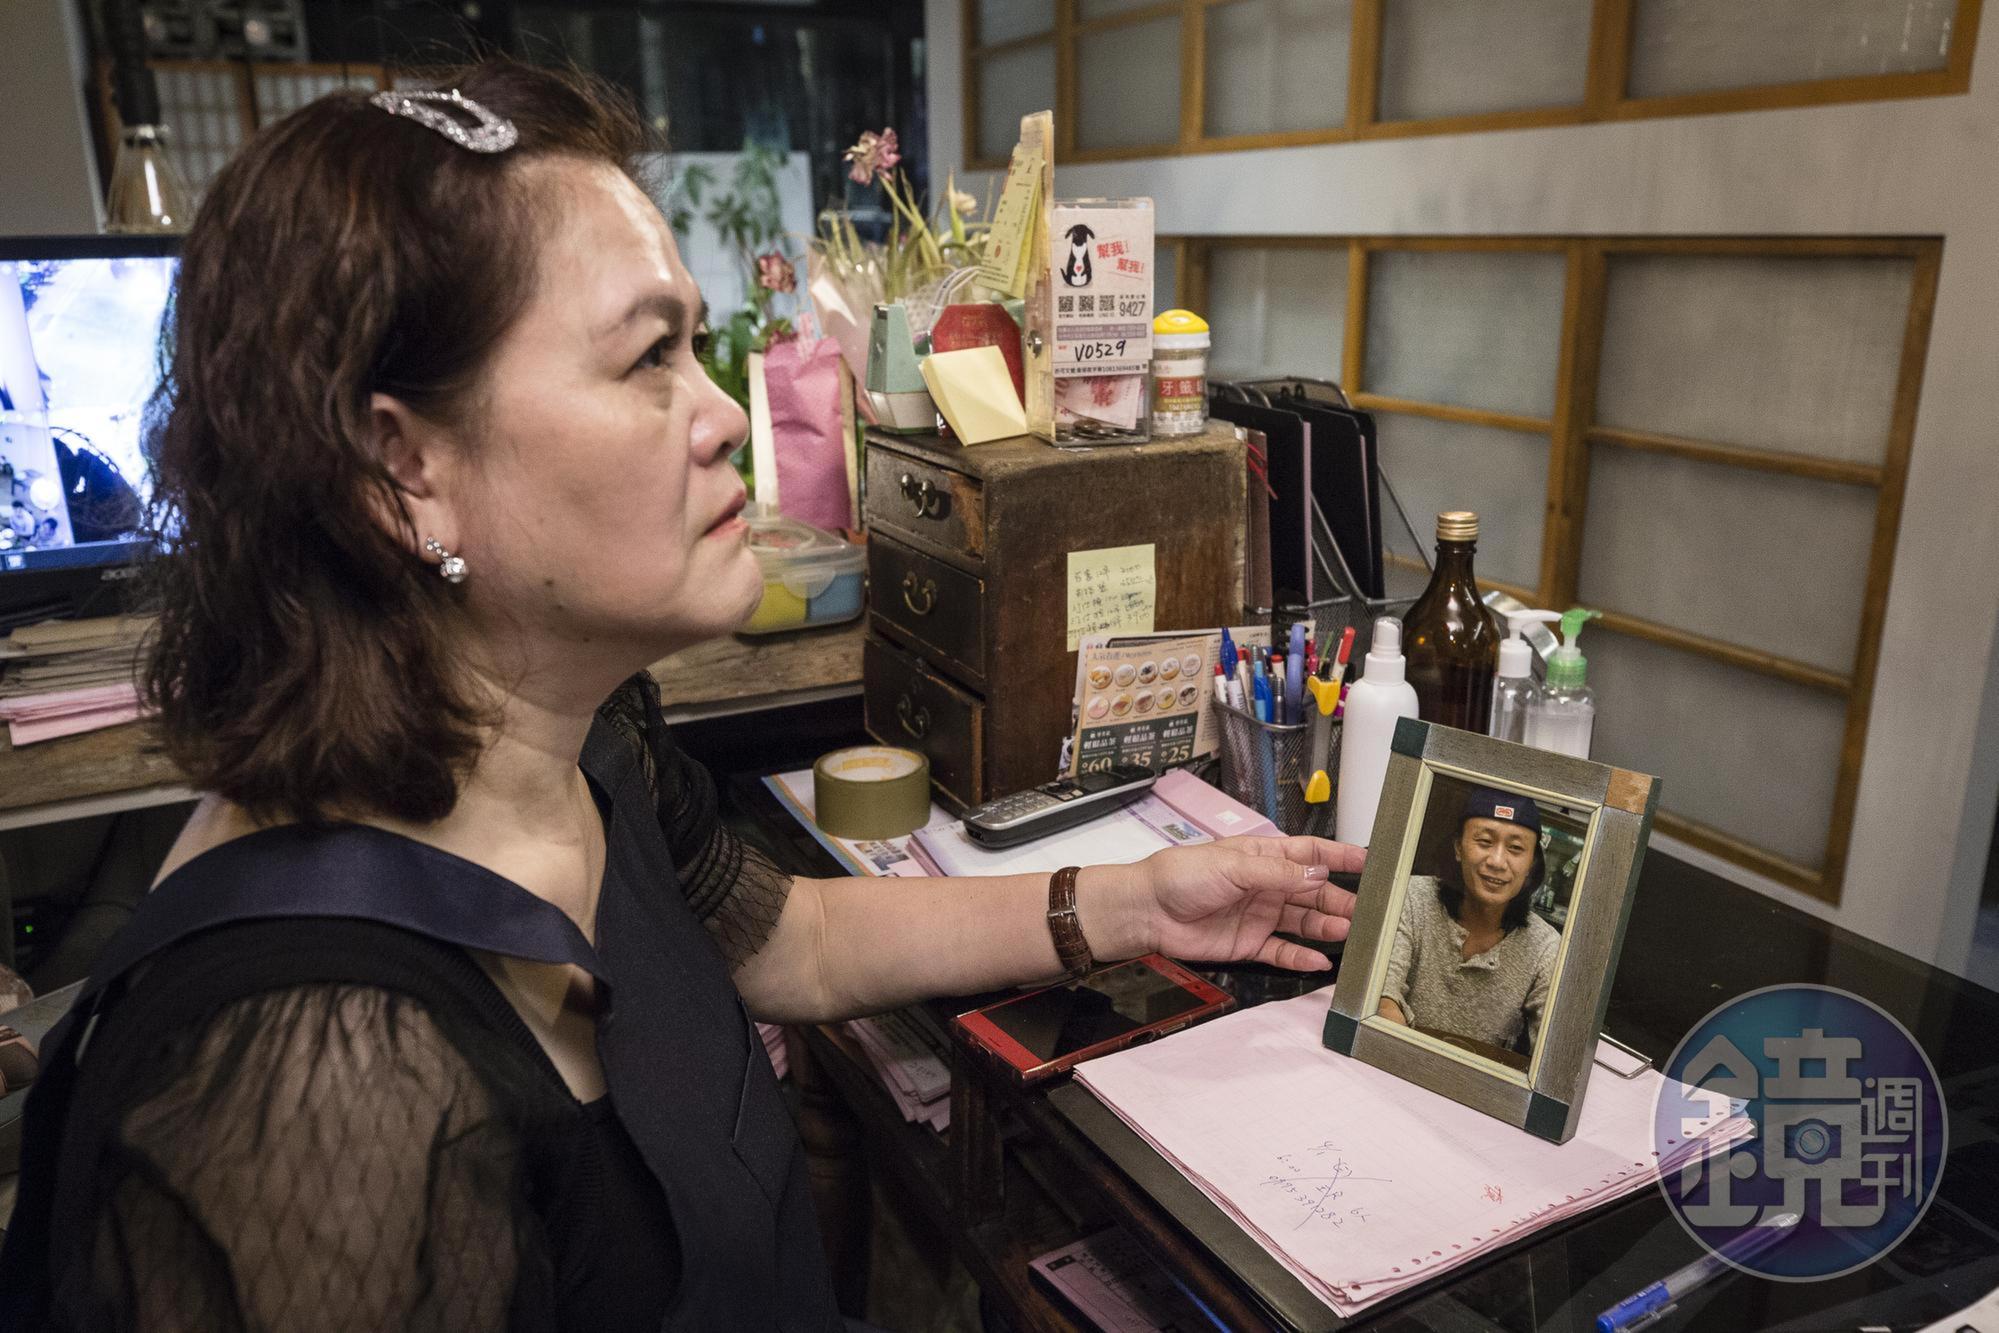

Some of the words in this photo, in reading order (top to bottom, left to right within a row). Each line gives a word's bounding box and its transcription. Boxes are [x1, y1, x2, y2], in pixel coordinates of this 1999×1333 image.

[1119, 301, 1146, 317] 9427
[1074, 339, 1127, 361] V0529
[1167, 744, 1191, 763] 25
[1088, 756, 1113, 774] 60
